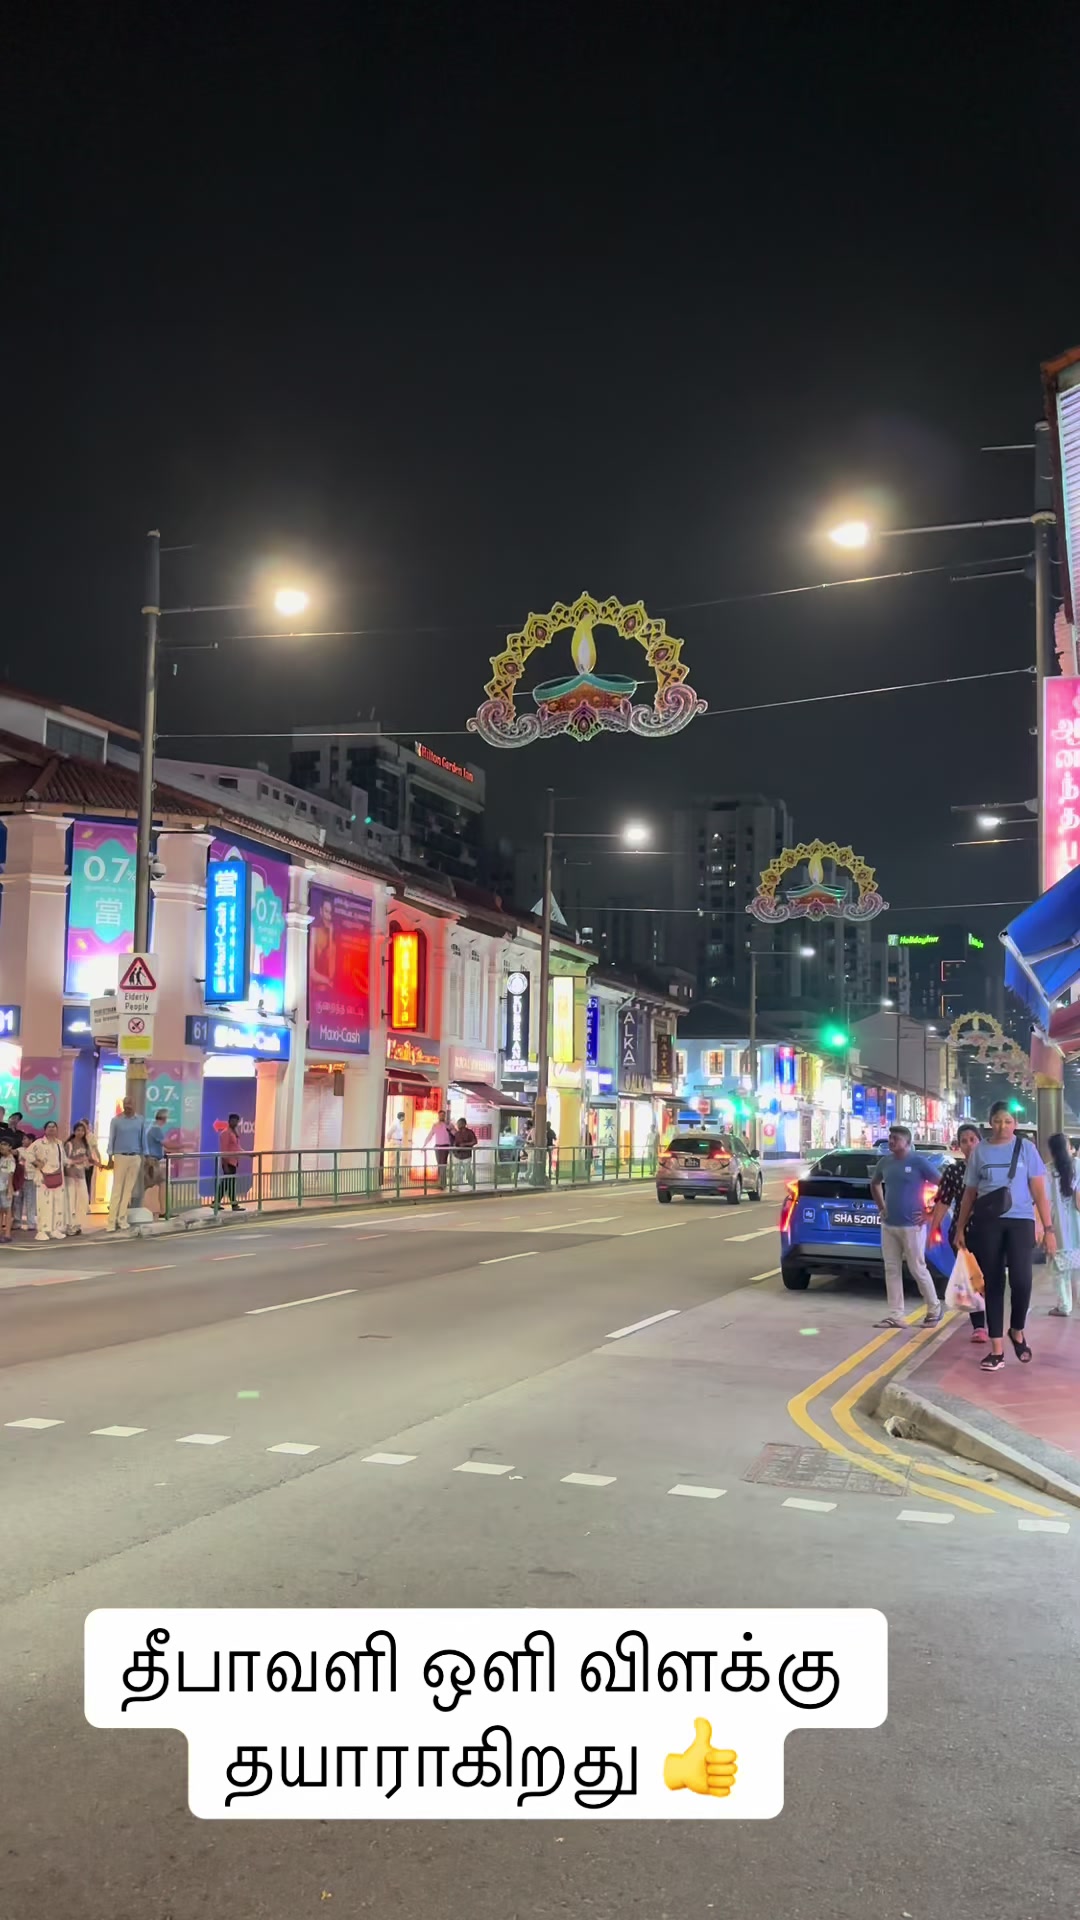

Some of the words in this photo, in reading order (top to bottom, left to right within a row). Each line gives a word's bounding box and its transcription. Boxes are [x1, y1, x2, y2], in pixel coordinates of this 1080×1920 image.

[422, 745, 441, 766] Hilton
[442, 756, 463, 777] Garden
[463, 767, 474, 782] Inn
[125, 993, 149, 1003] Elderly
[125, 1003, 148, 1012] People
[193, 1021, 208, 1040] 61
[319, 1023, 361, 1044] Maxi-Cash
[623, 1011, 636, 1063] ALKA
[26, 1092, 52, 1104] GST
[834, 1212, 853, 1224] SHA
